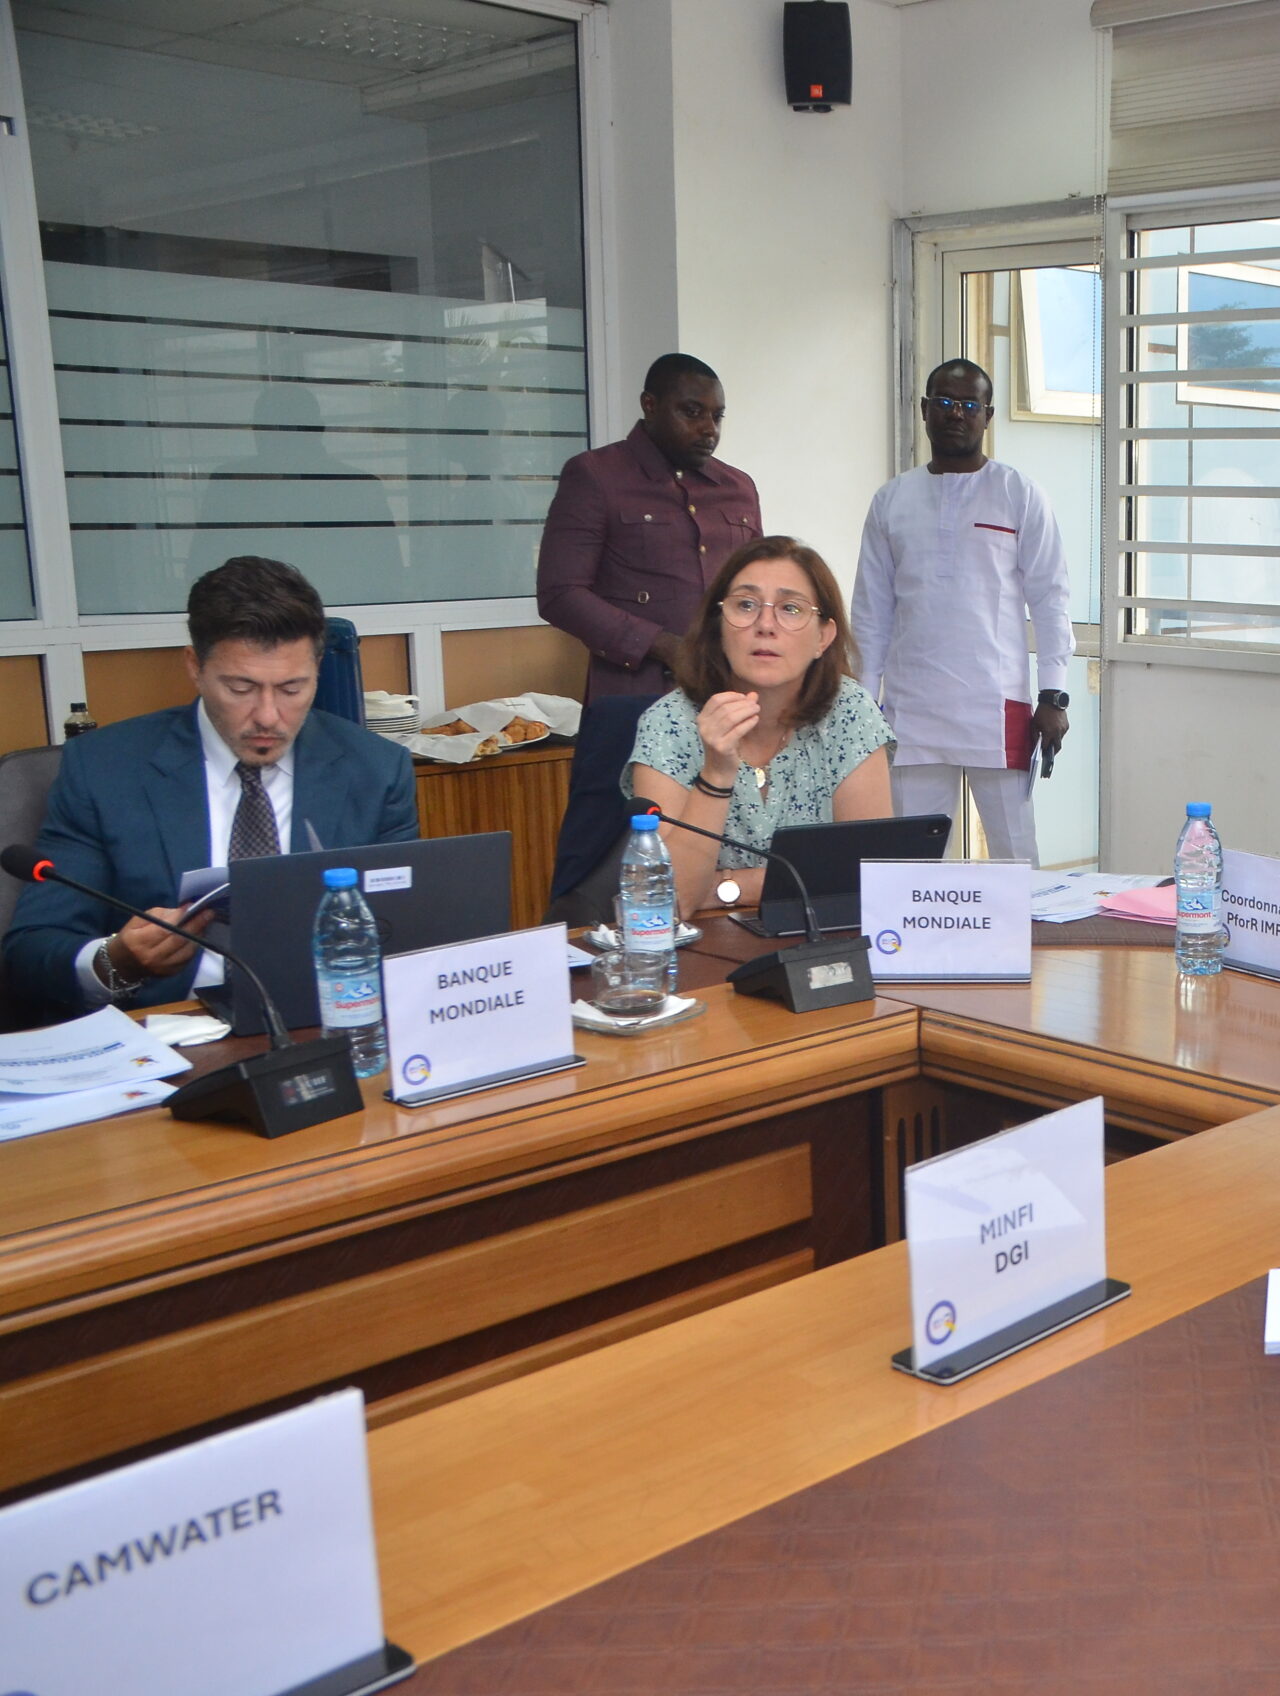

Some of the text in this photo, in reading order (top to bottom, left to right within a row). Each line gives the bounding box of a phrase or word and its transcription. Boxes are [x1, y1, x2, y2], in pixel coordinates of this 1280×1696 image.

[912, 889, 982, 905] BANQUE
[902, 916, 991, 930] MONDIALE
[1226, 911, 1258, 932] PforR
[437, 960, 513, 990] BANQUE
[429, 989, 525, 1025] MONDIALE
[980, 1202, 1034, 1245] MINFI
[994, 1239, 1030, 1274] DGI
[25, 1489, 283, 1607] CAMWATER
